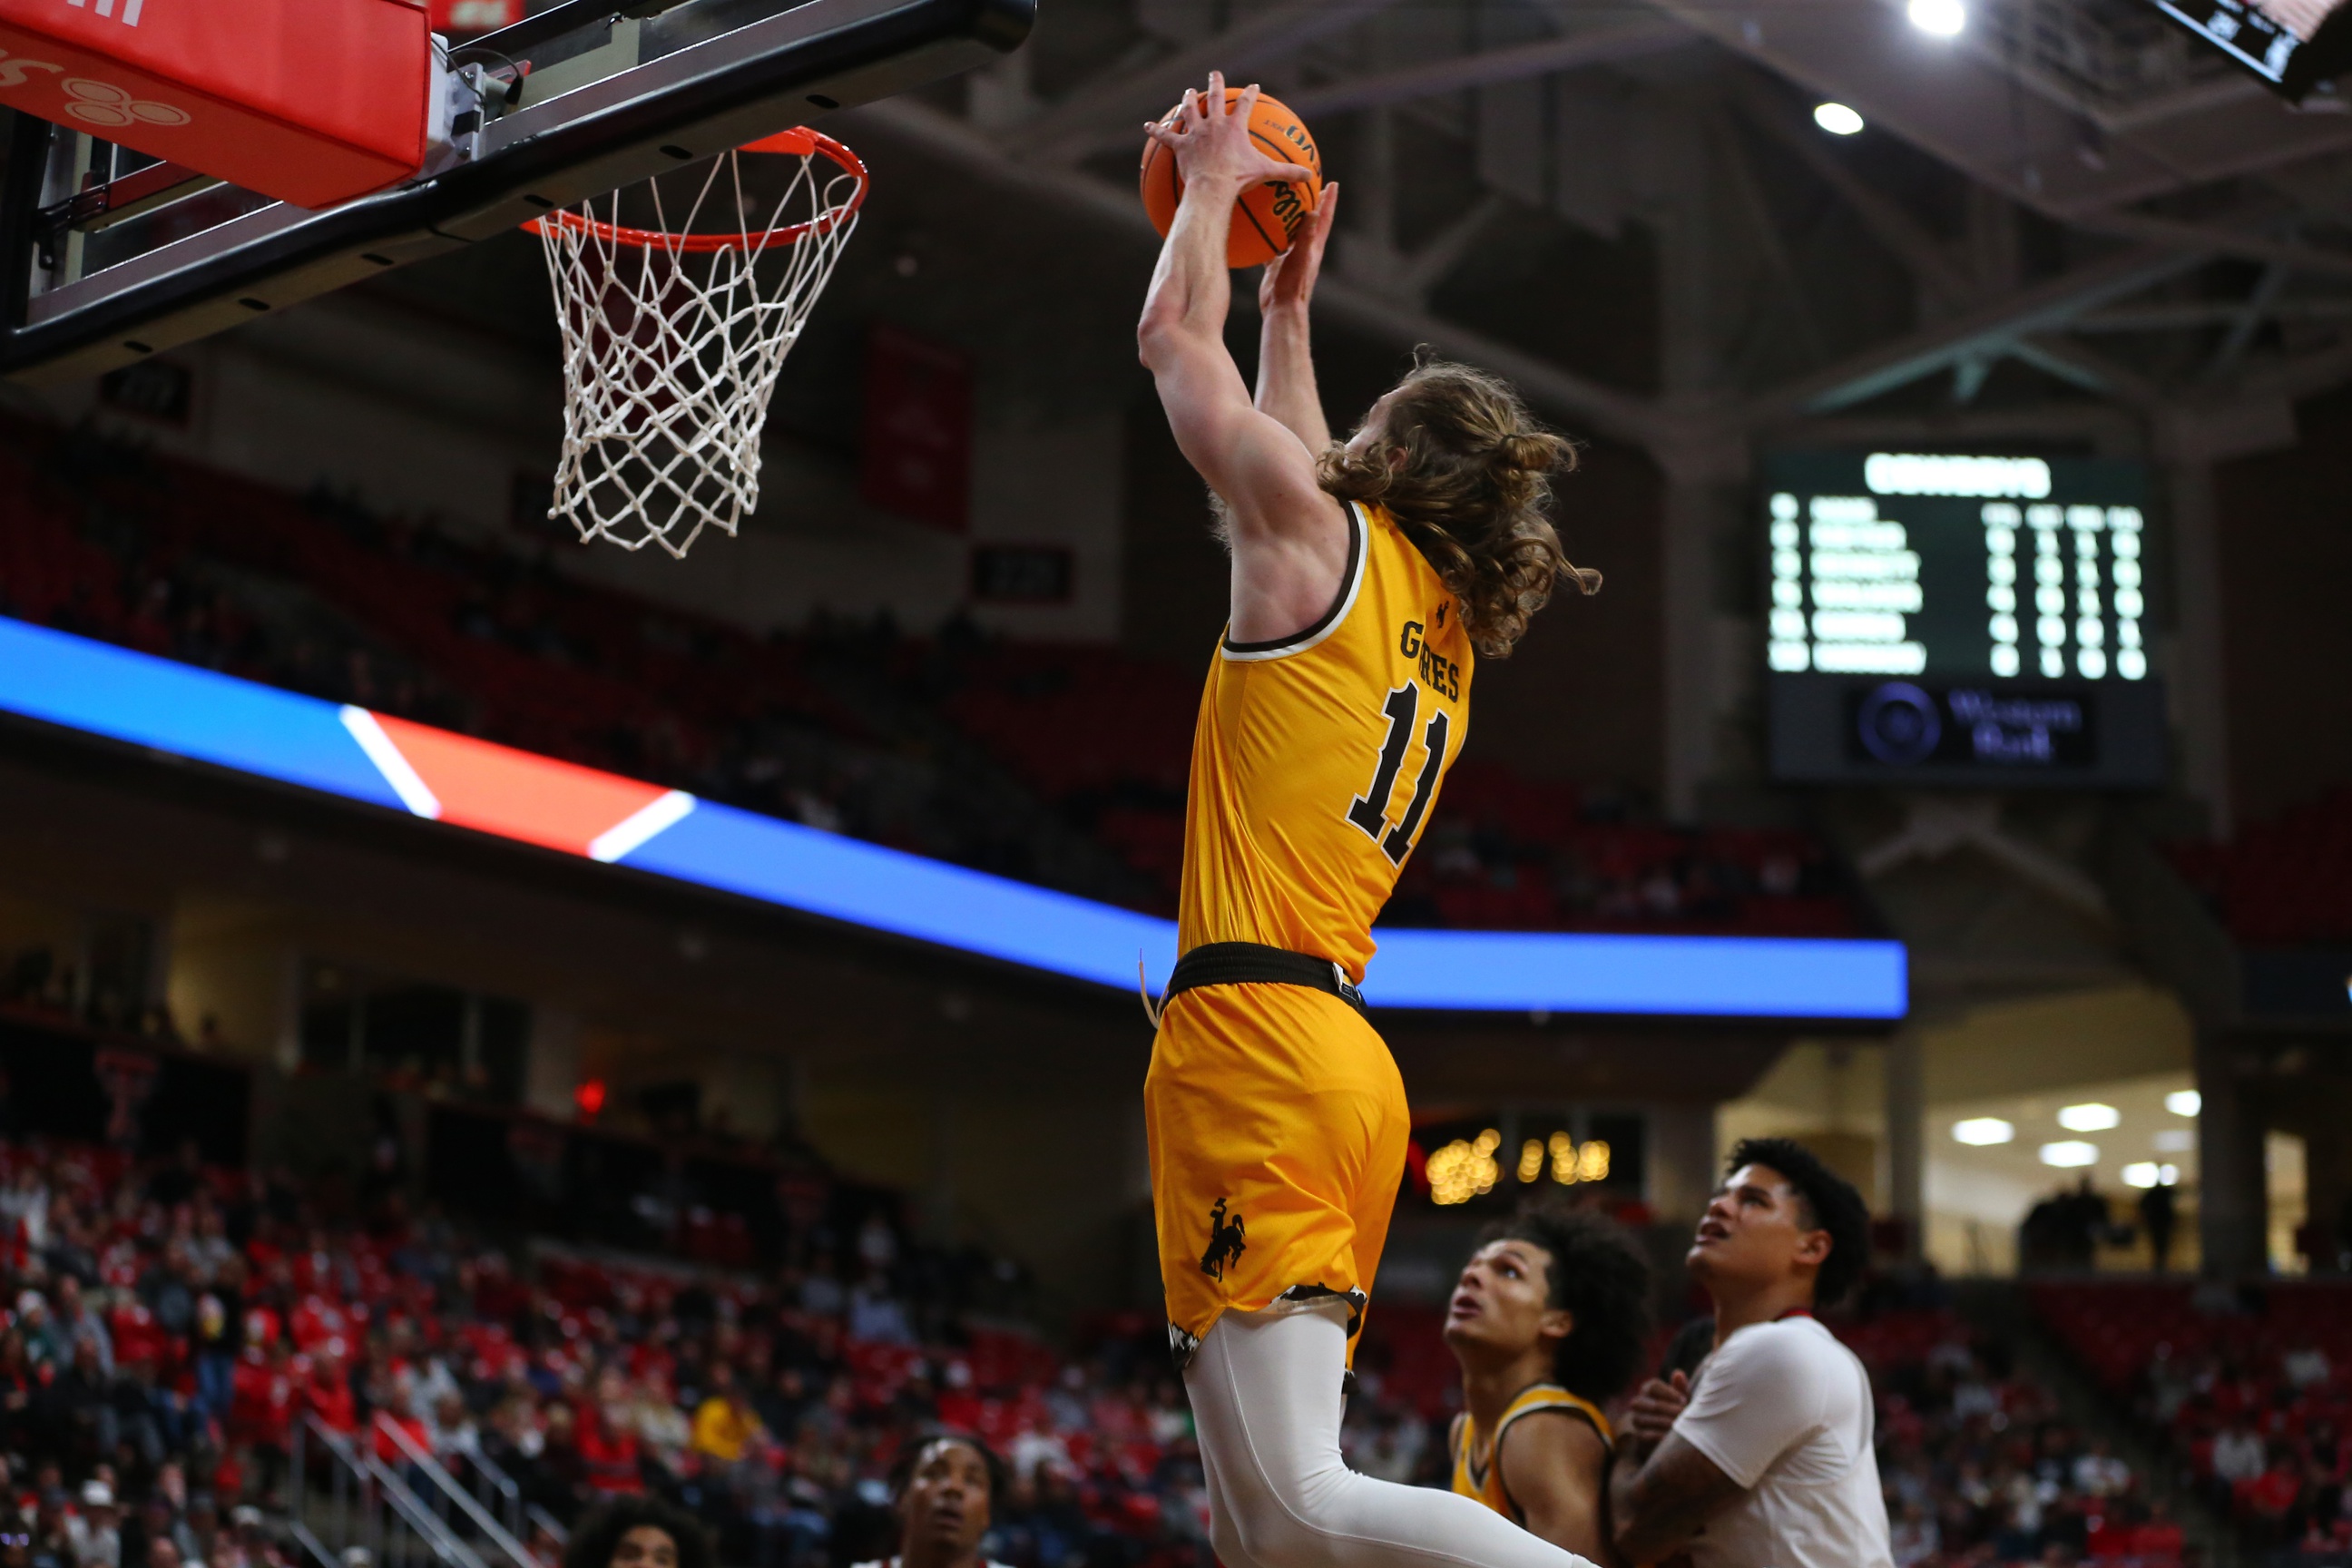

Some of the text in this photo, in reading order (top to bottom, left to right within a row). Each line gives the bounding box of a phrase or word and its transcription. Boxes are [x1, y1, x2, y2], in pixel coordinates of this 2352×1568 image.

[1285, 125, 1322, 178] VO
[1264, 181, 1306, 242] ils
[1400, 621, 1459, 703] GRES
[1345, 677, 1449, 869] 11
